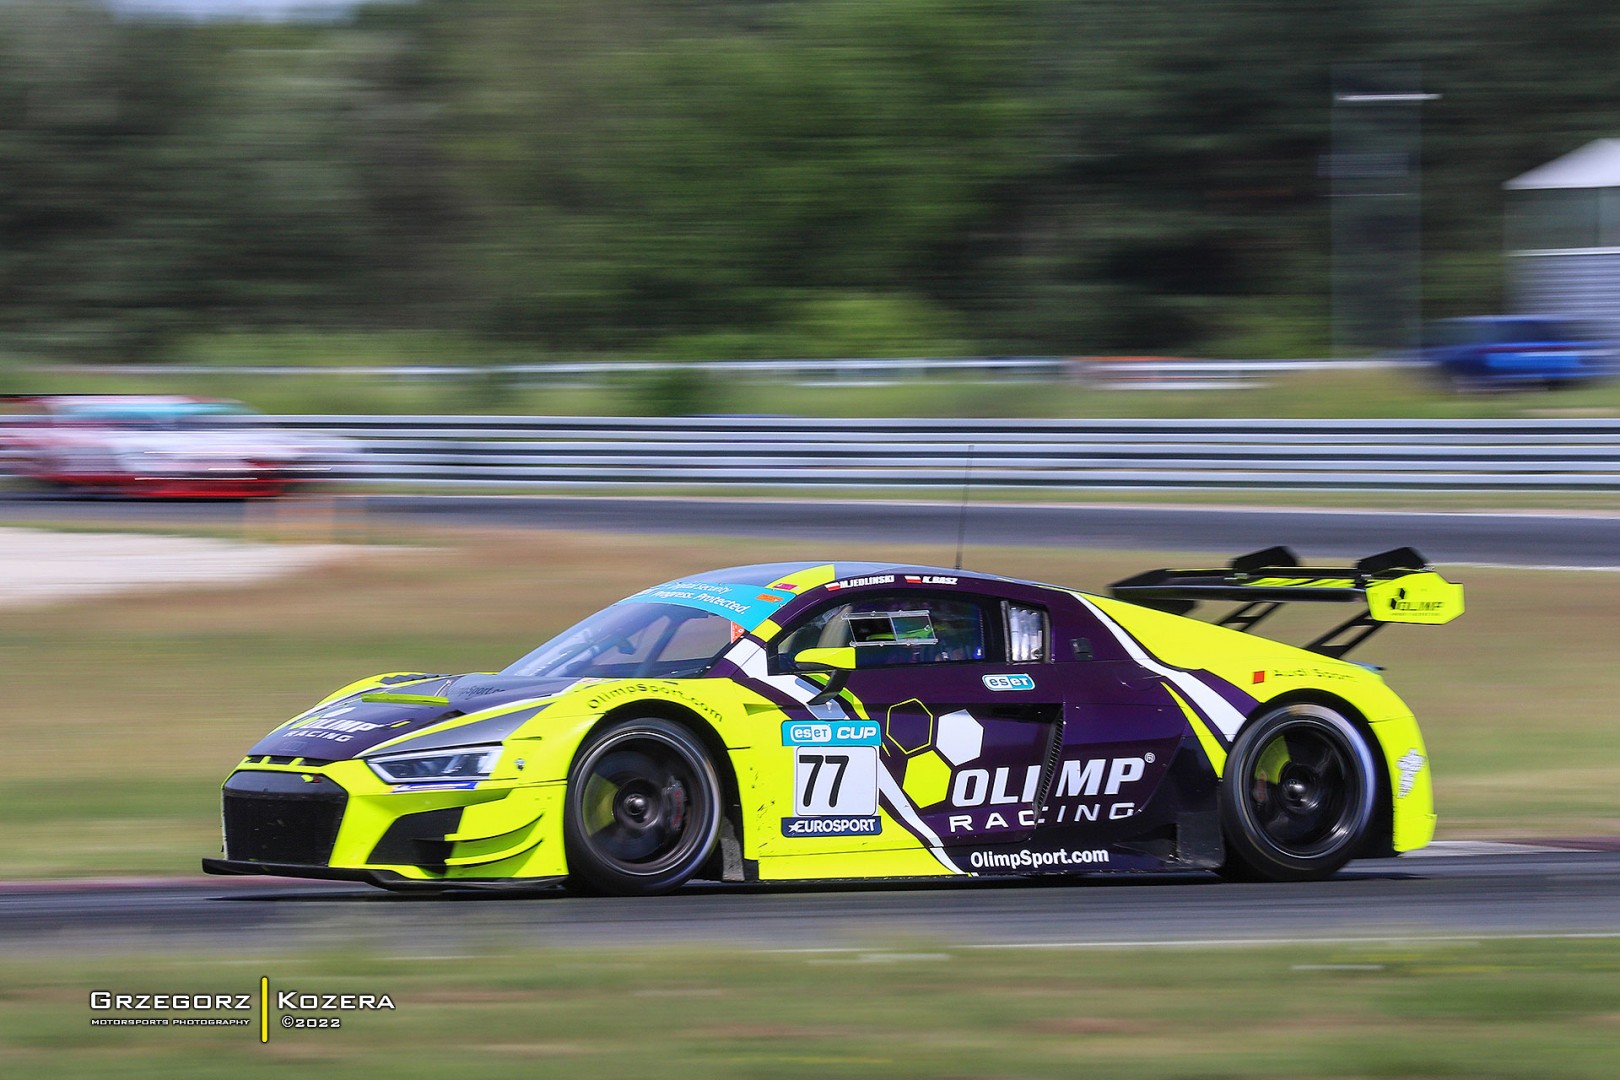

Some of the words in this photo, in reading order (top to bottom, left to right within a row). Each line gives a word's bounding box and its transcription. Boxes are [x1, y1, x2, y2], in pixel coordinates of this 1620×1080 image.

[922, 575, 958, 585] K.BASZ
[692, 593, 751, 614] Protected.
[298, 719, 378, 732] OLIMP
[836, 726, 877, 739] CUP
[284, 730, 354, 742] RACING
[798, 754, 850, 808] 77
[949, 802, 1136, 833] RACING
[789, 818, 876, 833] EUROSPORT
[970, 848, 1110, 870] OlimpSport.com
